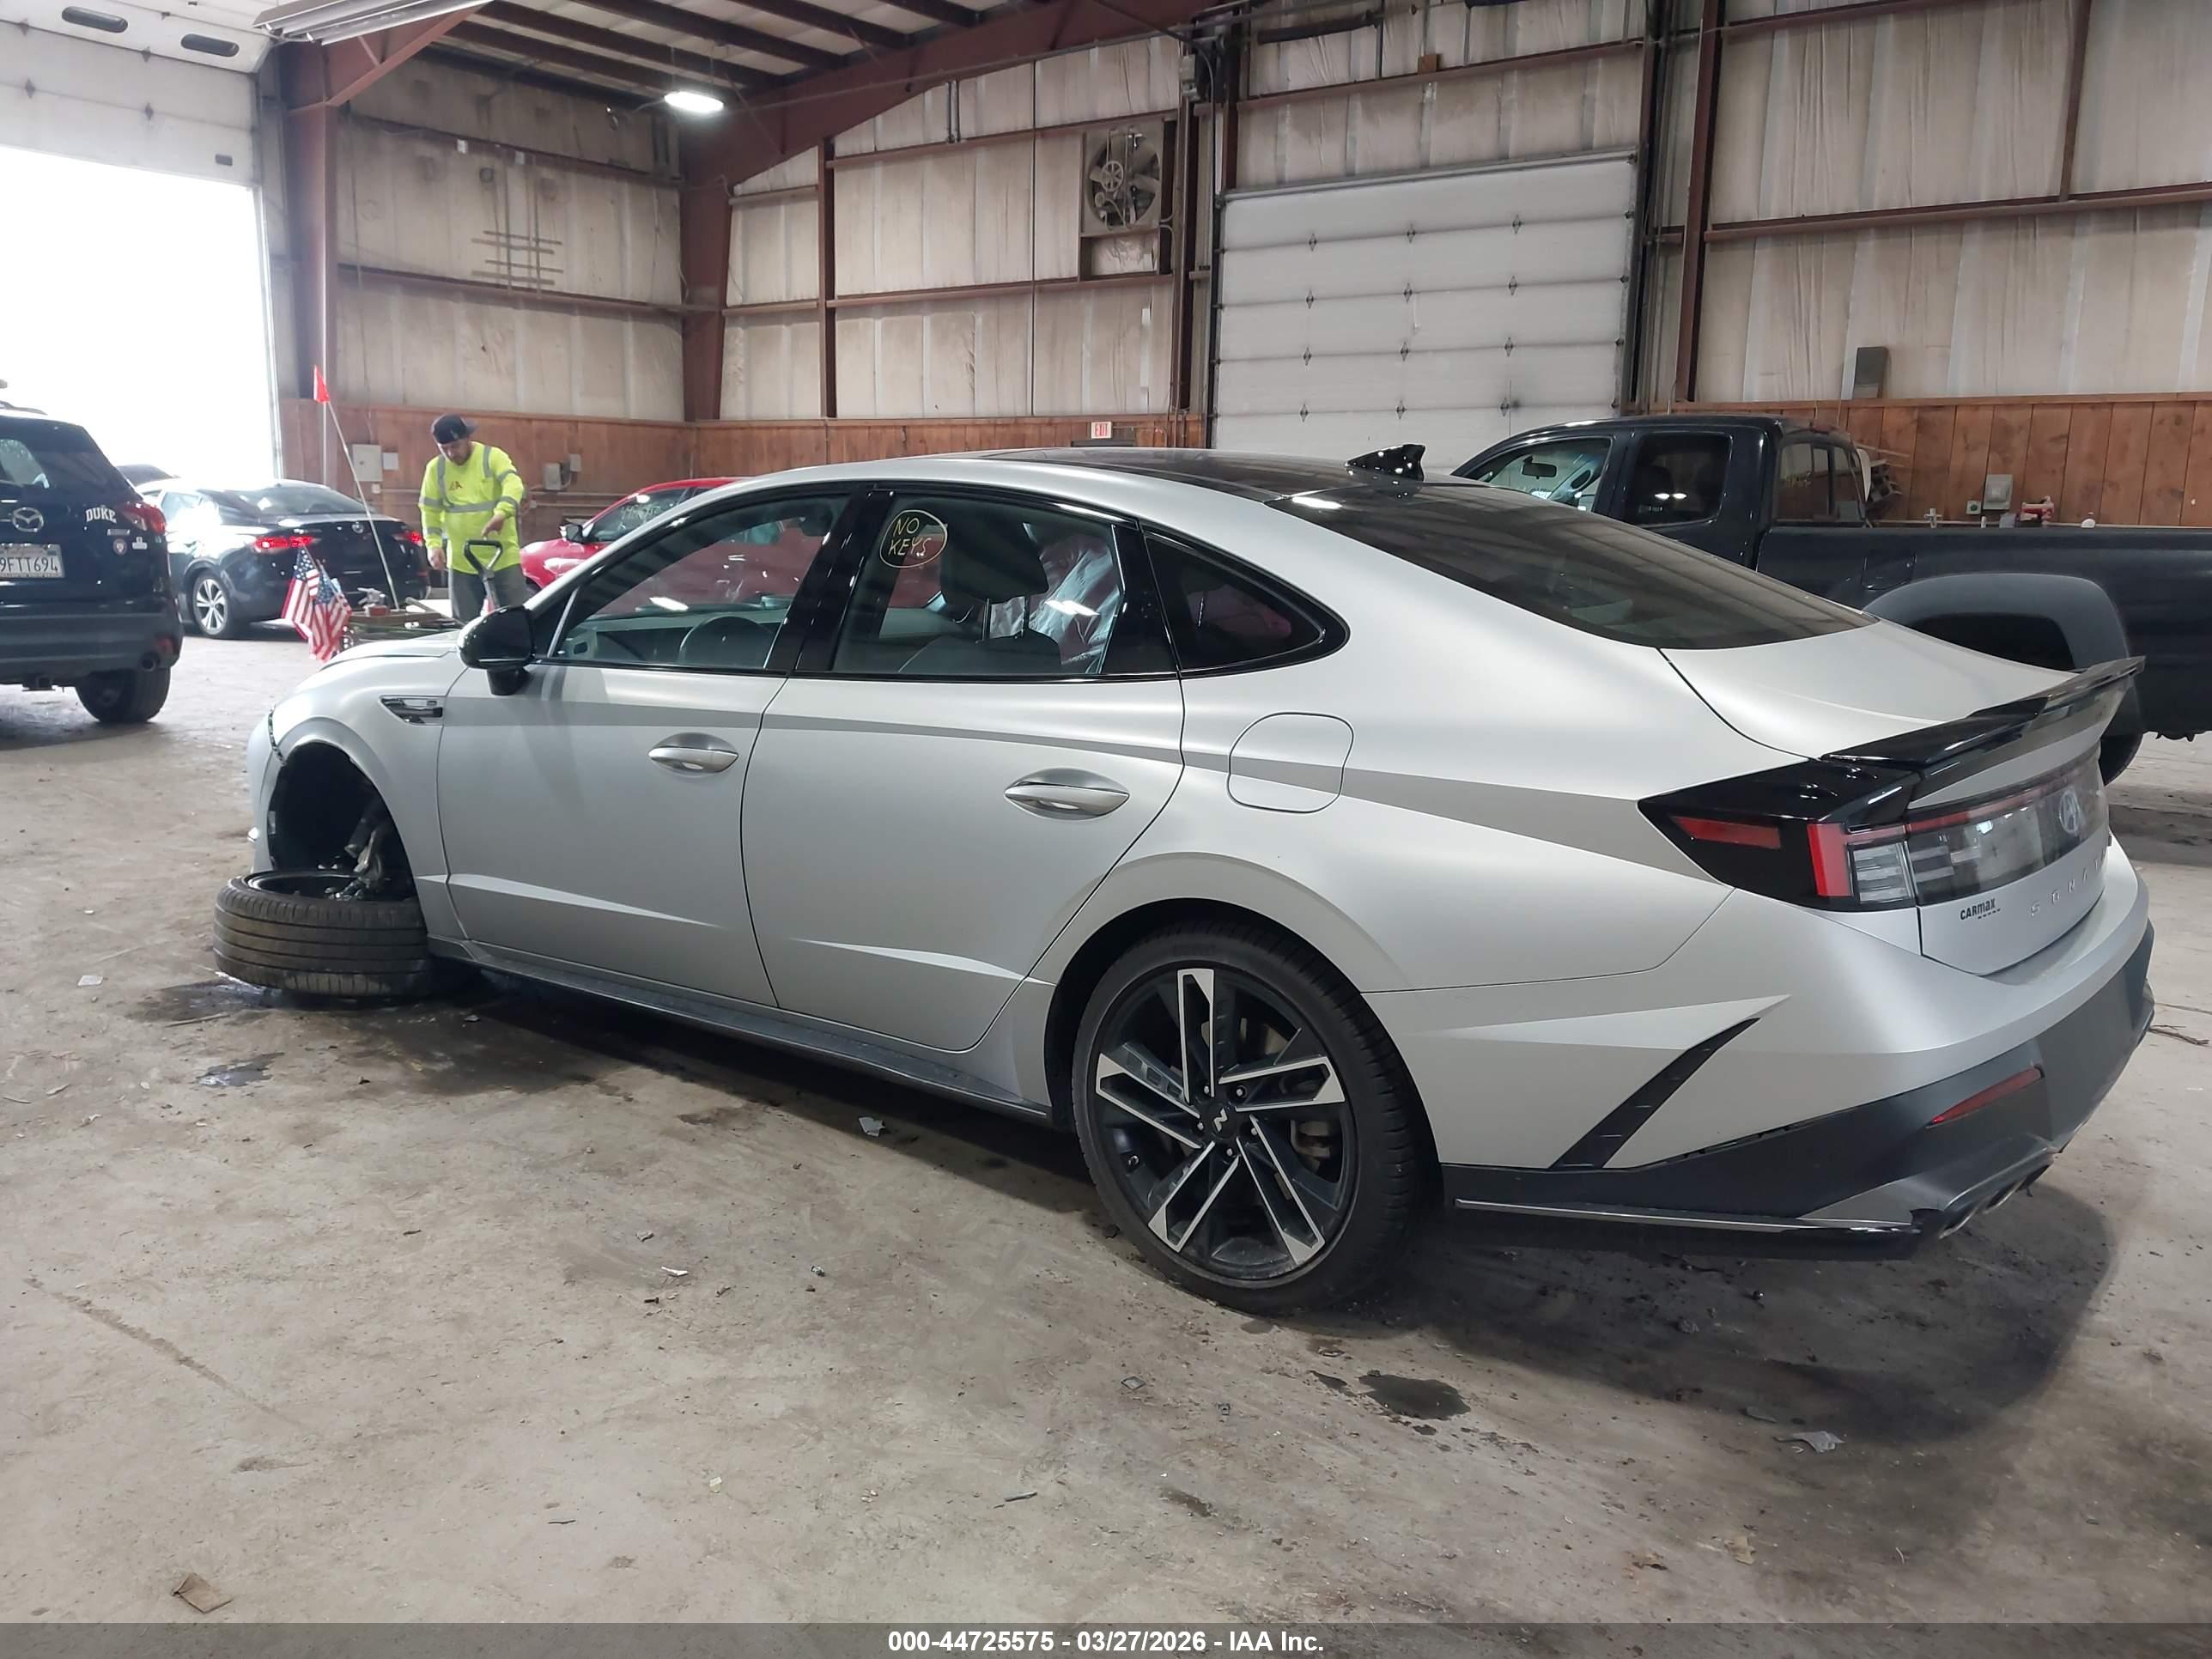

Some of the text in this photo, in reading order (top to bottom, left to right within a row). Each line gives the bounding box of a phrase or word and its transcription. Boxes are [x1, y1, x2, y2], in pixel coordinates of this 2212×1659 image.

[85, 507, 118, 524] DUKE
[893, 517, 920, 537] NO
[888, 537, 933, 556] KEYS
[0, 556, 58, 572] 9FTT694
